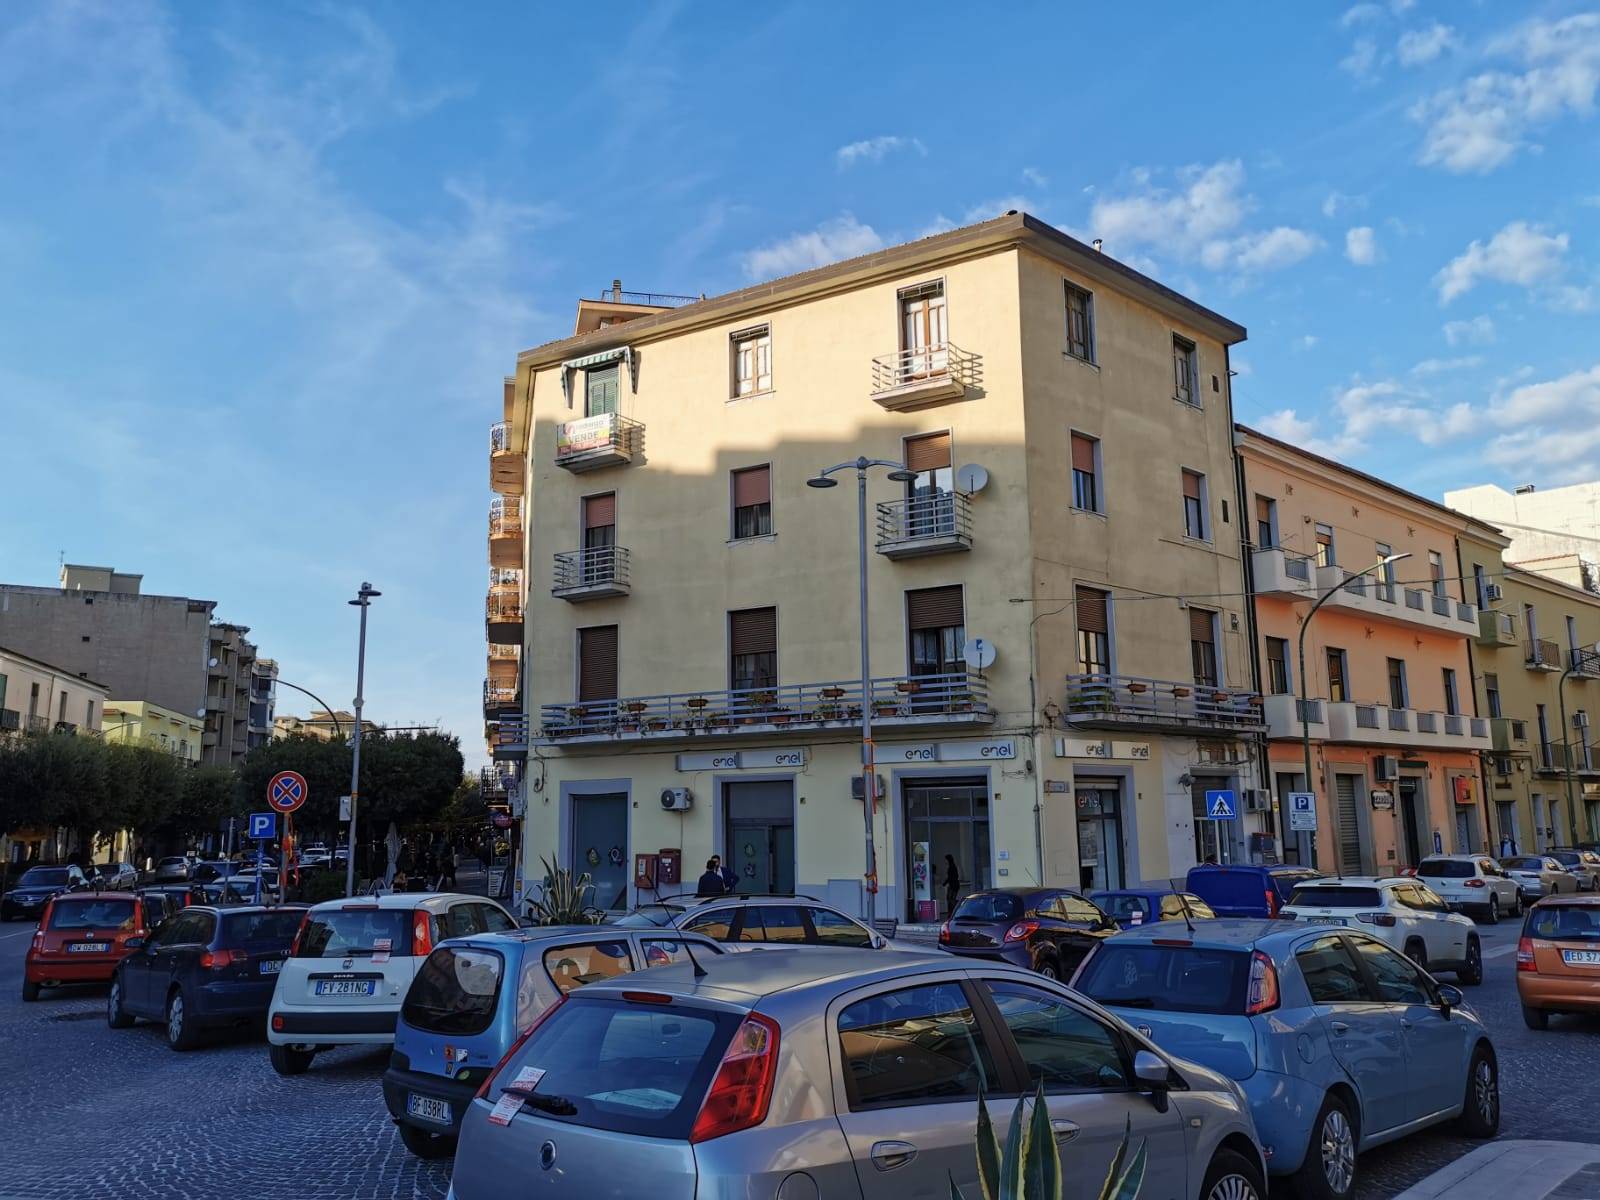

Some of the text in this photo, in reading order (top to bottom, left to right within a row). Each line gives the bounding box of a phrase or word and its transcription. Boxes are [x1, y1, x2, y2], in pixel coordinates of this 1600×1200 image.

[904, 747, 935, 760] enel
[981, 743, 1012, 757] enel
[1085, 744, 1105, 756] enel
[1131, 745, 1149, 757] enel
[712, 755, 737, 767] enel
[775, 751, 801, 764] enel
[1078, 793, 1101, 808] enel
[1298, 798, 1307, 809] P
[254, 816, 270, 835] P
[1571, 952, 1600, 962] ED 37
[322, 982, 368, 993] FV 281NG
[412, 1094, 448, 1119] BF 038RL
